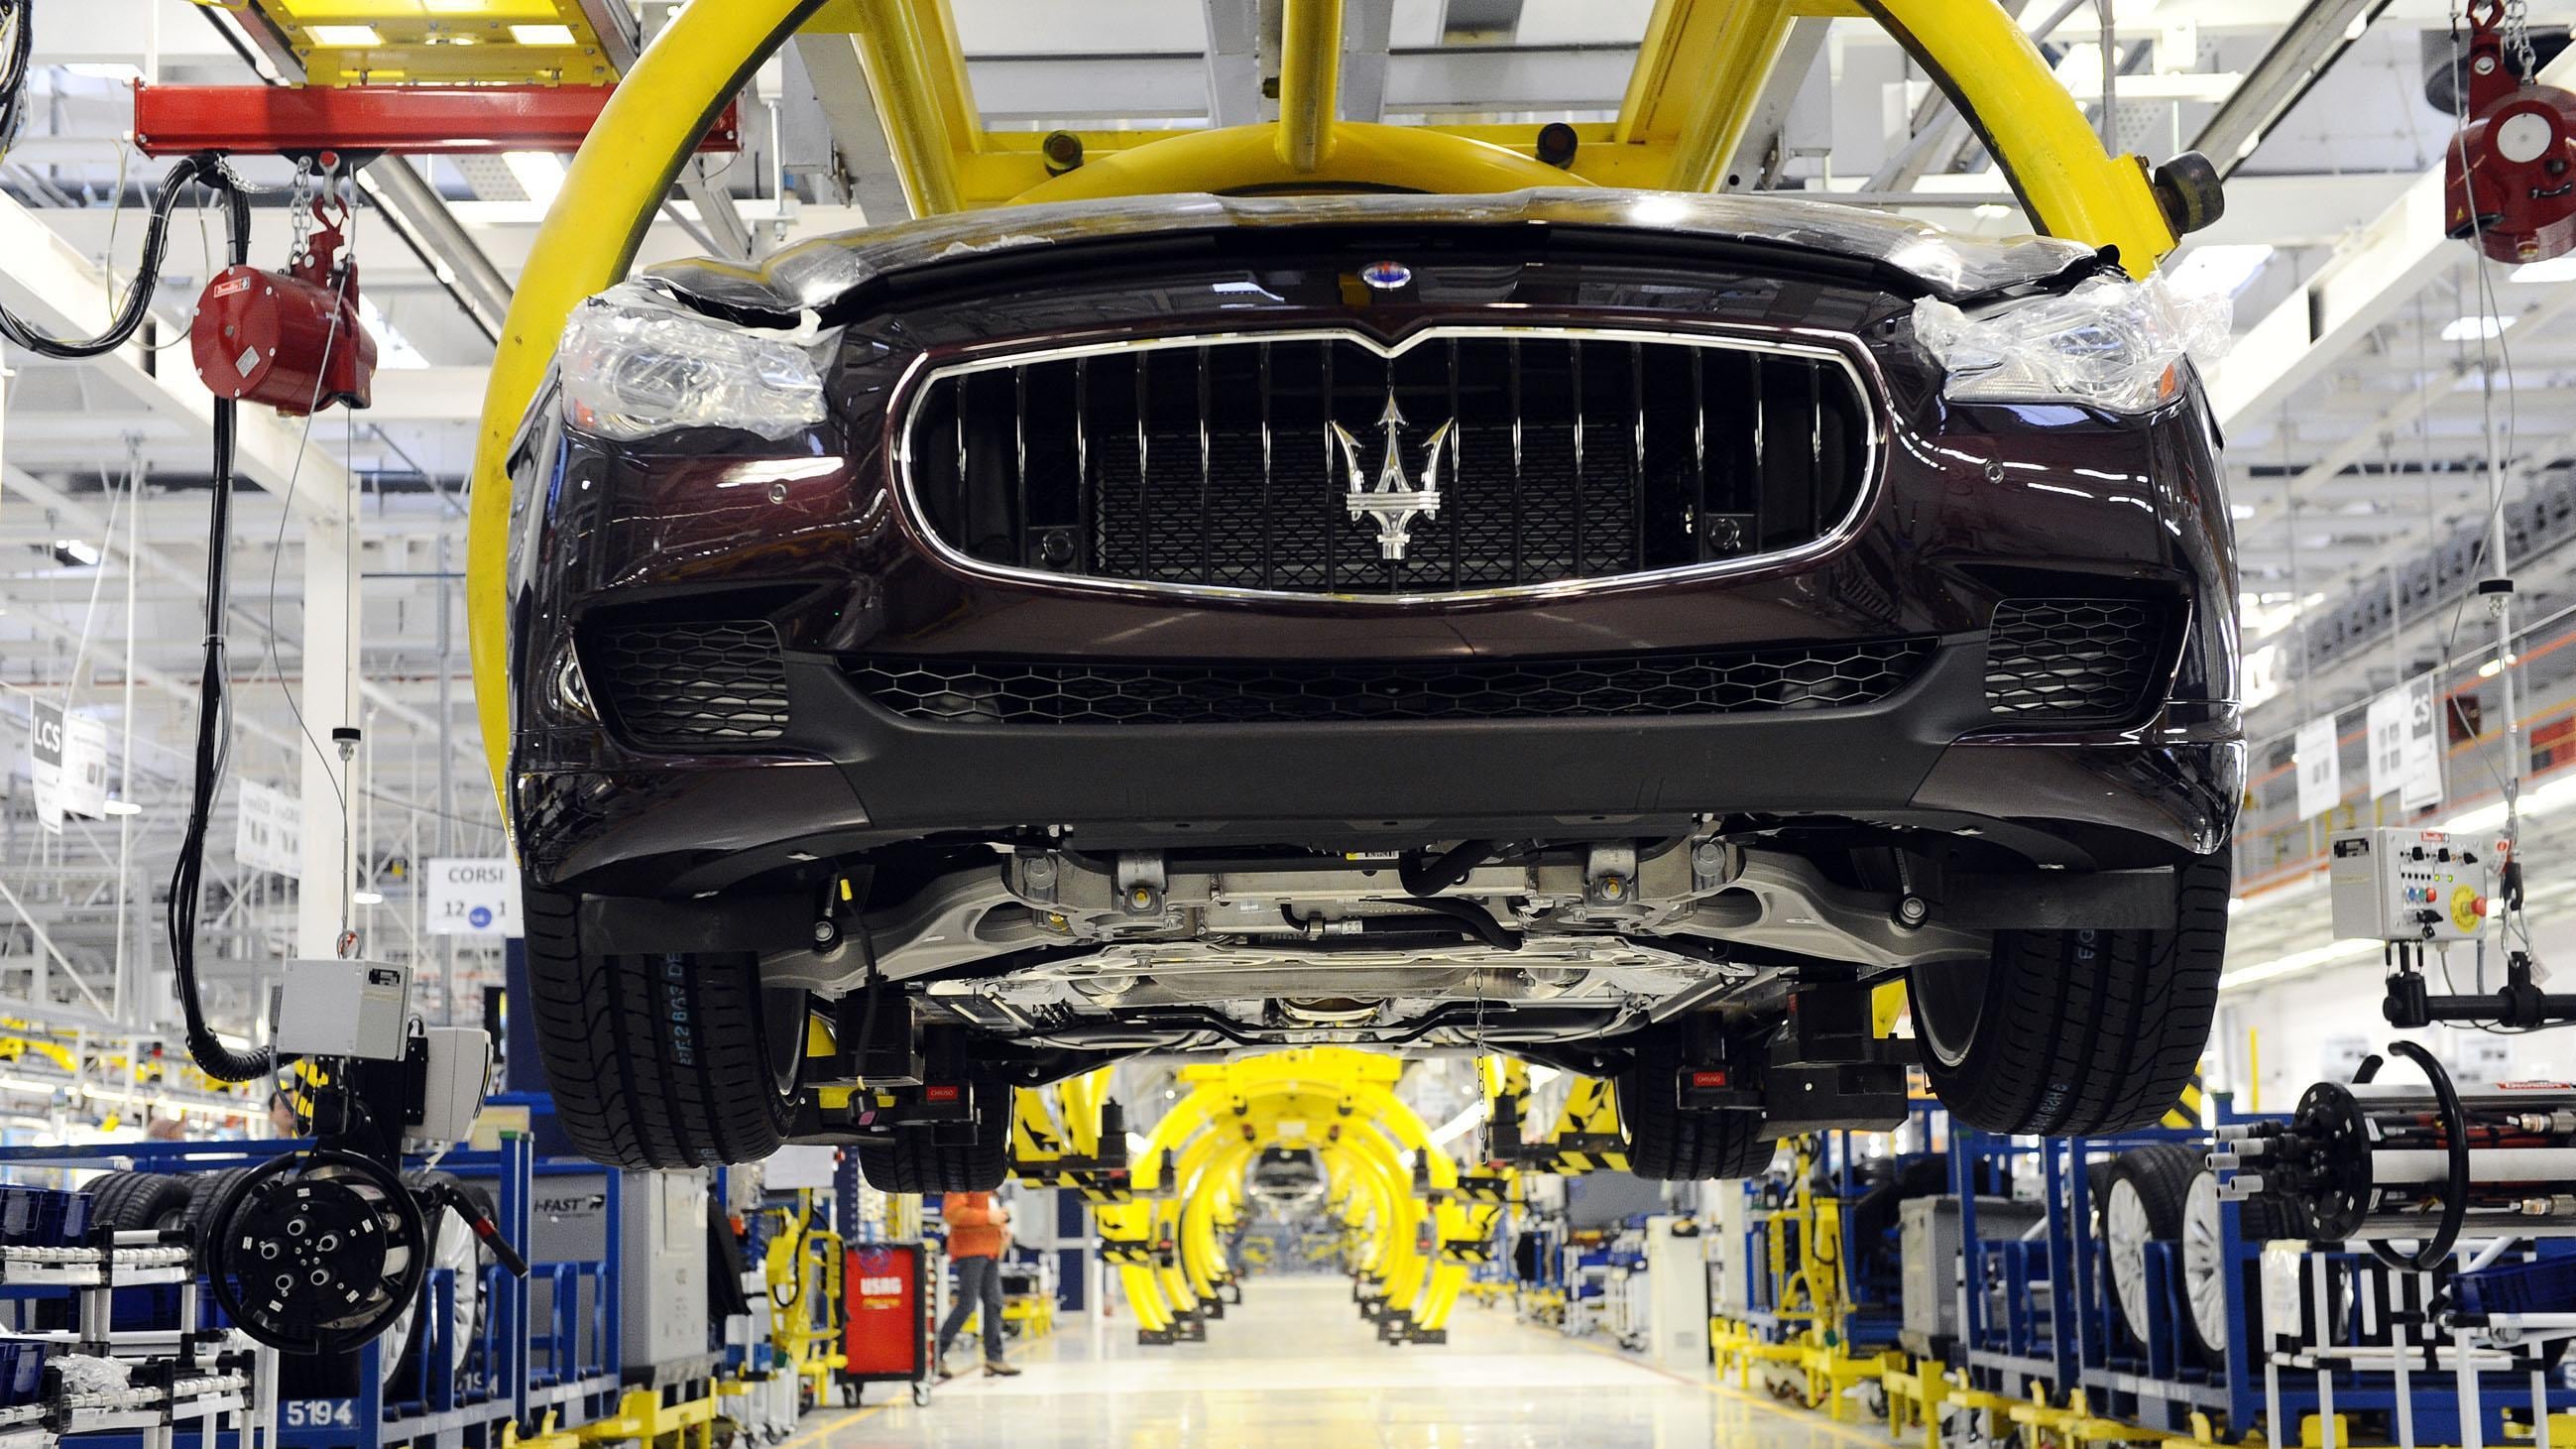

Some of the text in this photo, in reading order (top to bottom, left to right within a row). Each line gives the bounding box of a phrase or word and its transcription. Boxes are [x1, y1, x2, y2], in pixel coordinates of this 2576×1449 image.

[2411, 694, 2431, 727] CS
[34, 714, 61, 754] LCS
[444, 900, 466, 917] 12
[287, 1398, 353, 1426] 5194
